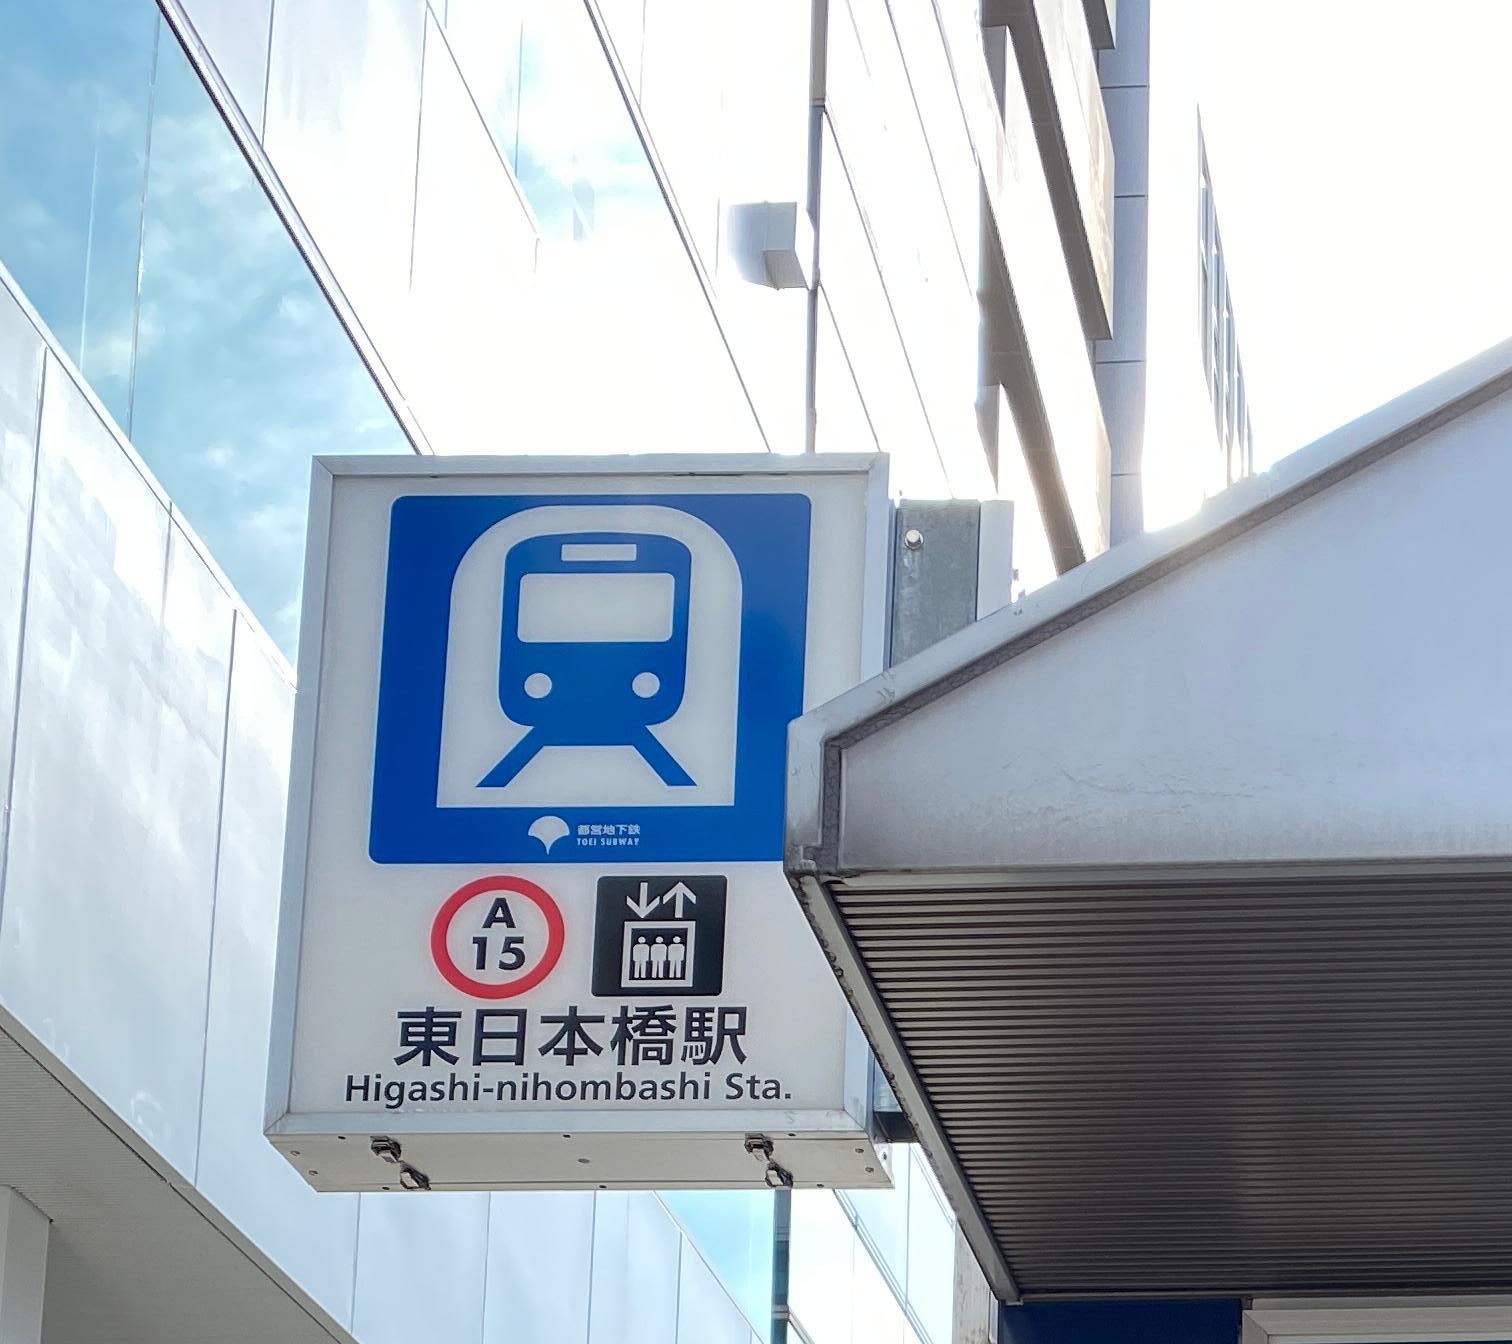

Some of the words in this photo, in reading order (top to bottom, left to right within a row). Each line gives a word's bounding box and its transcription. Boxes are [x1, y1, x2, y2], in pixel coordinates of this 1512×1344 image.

[576, 837, 597, 846] TOEI
[600, 837, 640, 846] SUBWAY
[577, 824, 641, 836] 都営地下鉄
[482, 897, 516, 929] A
[471, 936, 526, 971] 15
[393, 1005, 748, 1067] 東日本橋駅
[344, 1073, 711, 1109] Higashi-nihombashi
[724, 1072, 792, 1101] Sta.
